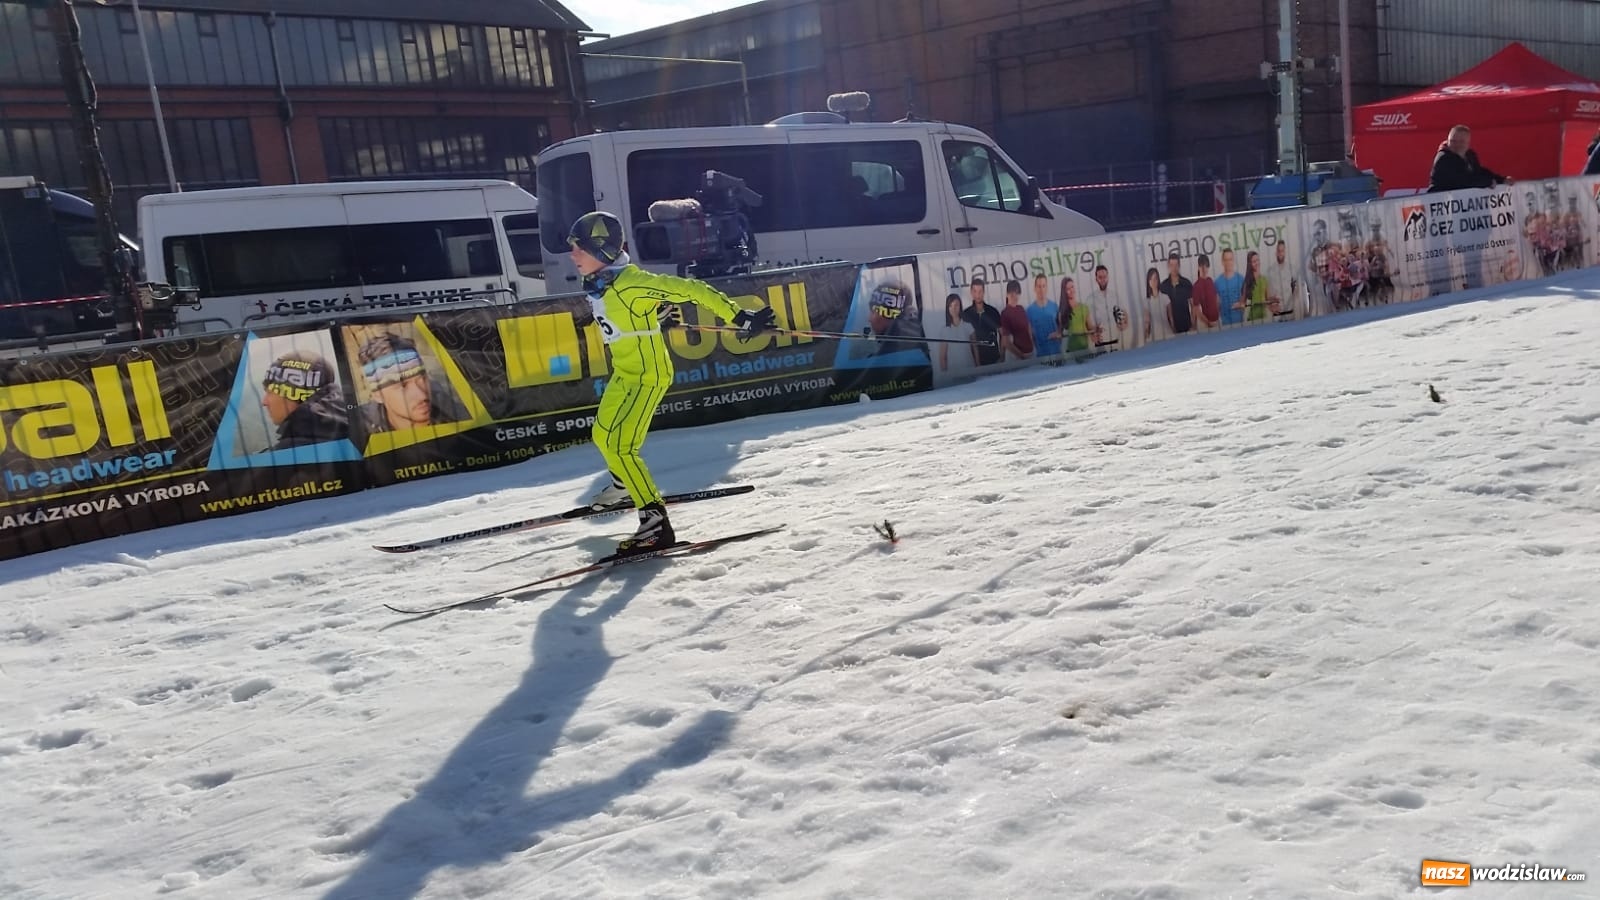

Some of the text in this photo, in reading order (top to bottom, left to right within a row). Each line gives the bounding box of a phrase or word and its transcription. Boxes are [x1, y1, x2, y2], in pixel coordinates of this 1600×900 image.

[1371, 112, 1412, 126] SWIX
[1460, 210, 1516, 233] DUATLON
[274, 287, 474, 317] ČESKÁ TELEVIZE
[715, 350, 816, 378] headwear
[0, 360, 171, 460] all
[495, 422, 548, 441] ČESKÉ
[703, 384, 782, 408] ZAKÁZKOVÁ
[784, 376, 836, 394] VÝROBA
[3, 449, 178, 492] headwear
[393, 460, 455, 479] RITUALL
[465, 453, 501, 467] Dolní
[504, 446, 536, 460] 1004
[0, 480, 211, 531] AKÁZKOVÁ VÝROBA
[200, 478, 345, 513] www.rituall.cz
